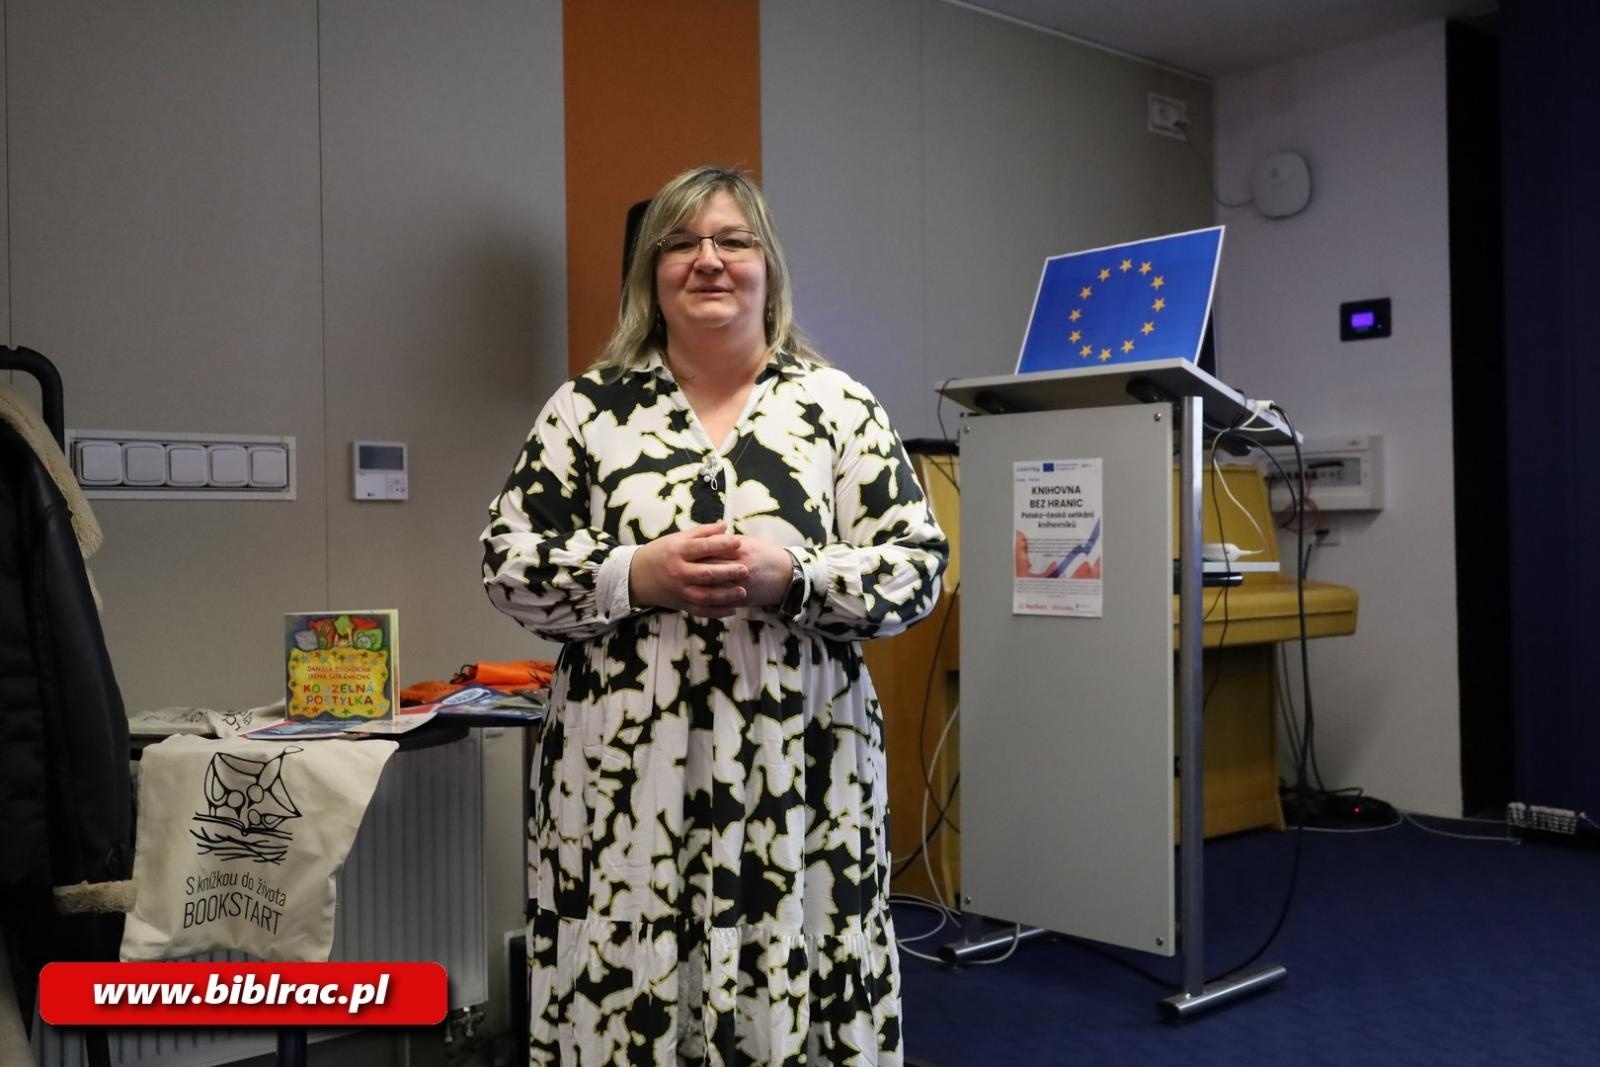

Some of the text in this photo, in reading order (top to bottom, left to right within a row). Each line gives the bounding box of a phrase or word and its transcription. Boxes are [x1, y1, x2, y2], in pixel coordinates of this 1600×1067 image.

[1031, 485, 1081, 495] KNIHOVNA
[1030, 498, 1083, 509] BEZ HRANIC
[303, 681, 374, 694] KOZELNÁ
[186, 870, 287, 907] S knížkou do života
[183, 891, 283, 935] BOOKSTART
